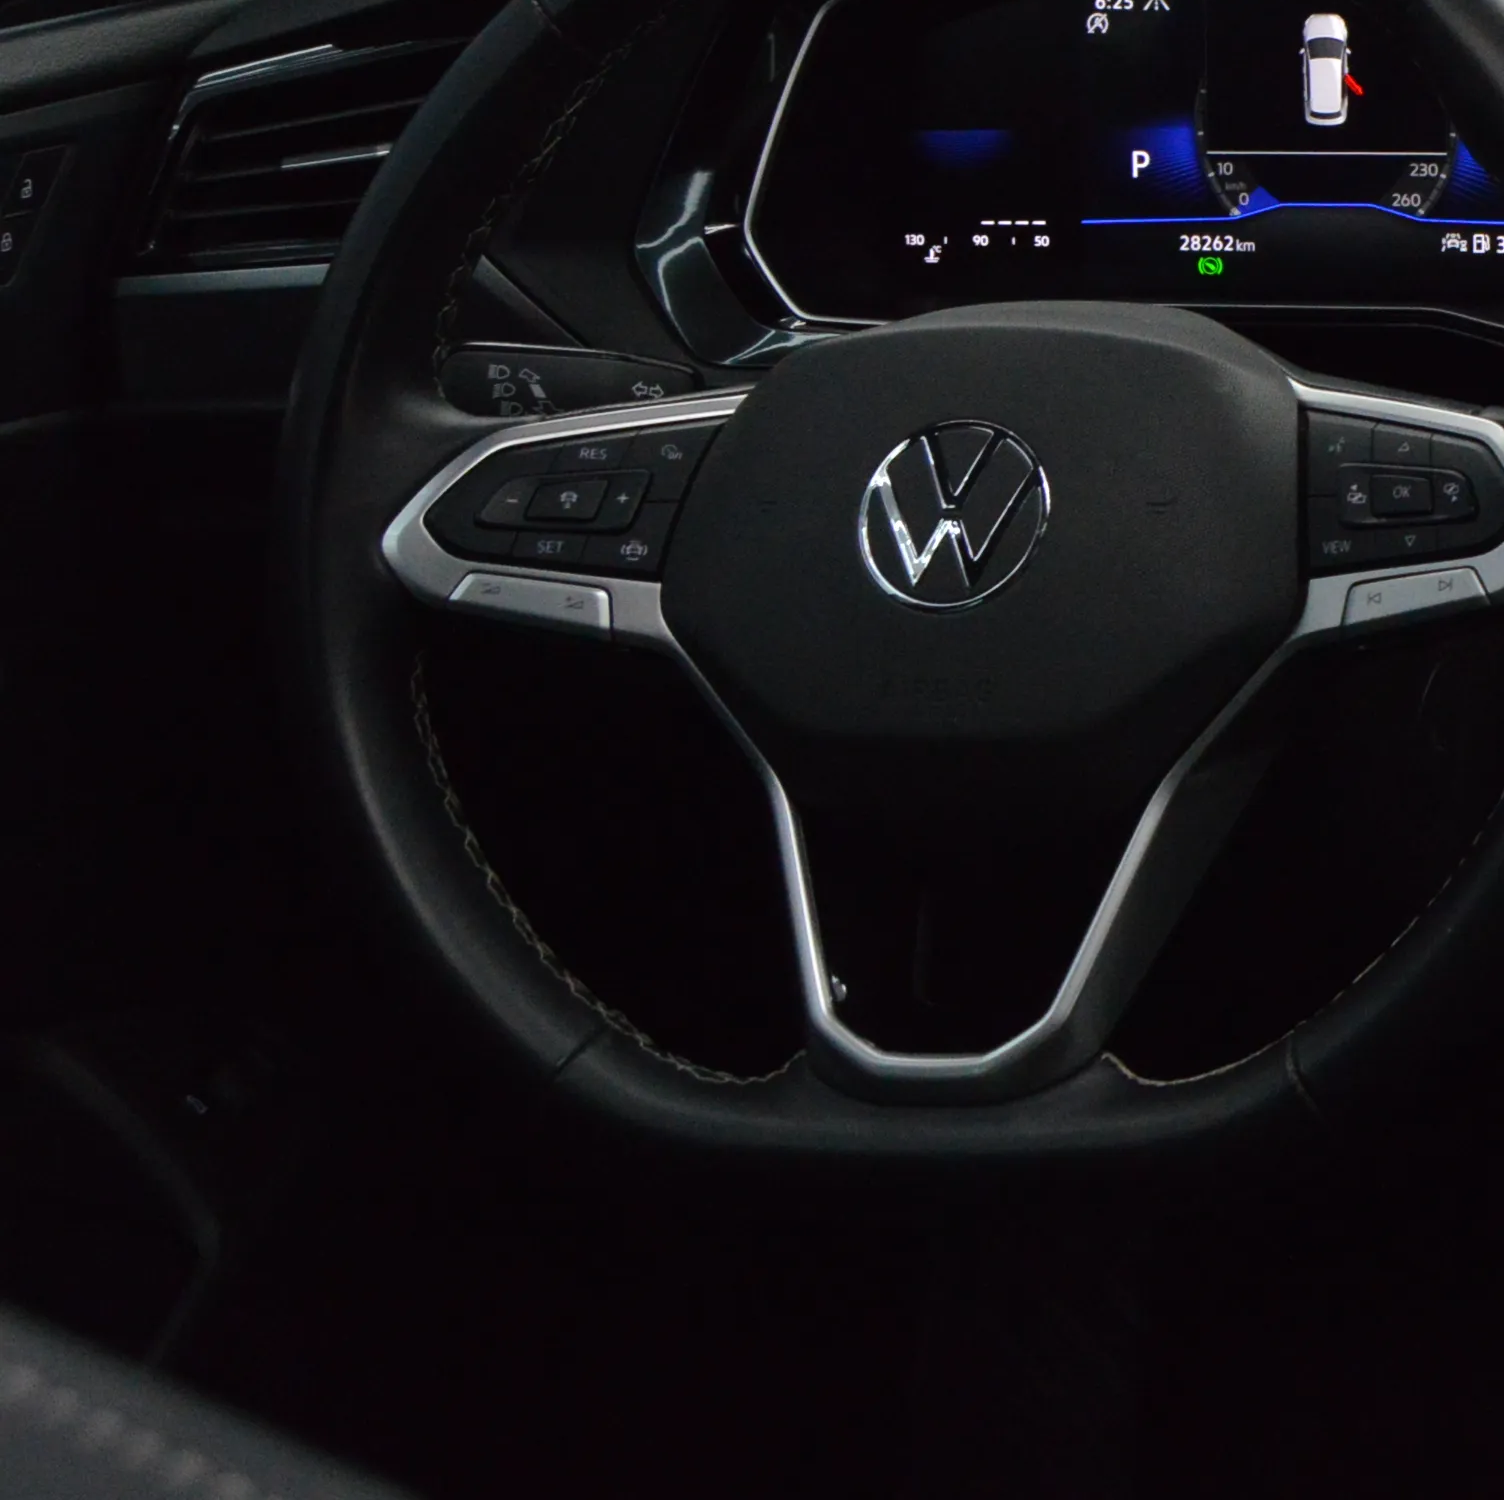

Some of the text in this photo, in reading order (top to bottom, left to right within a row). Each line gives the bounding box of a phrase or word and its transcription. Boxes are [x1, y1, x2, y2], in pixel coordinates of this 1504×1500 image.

[1130, 150, 1150, 178] P
[1216, 162, 1234, 176] 10
[1409, 163, 1438, 177] 230
[1238, 193, 1250, 206] 0
[1392, 193, 1421, 207] 260
[905, 234, 1050, 247] 130 90 50
[579, 448, 607, 461] RES
[1392, 485, 1412, 500] OK
[536, 539, 564, 554] SET
[1322, 539, 1352, 555] VIEW
